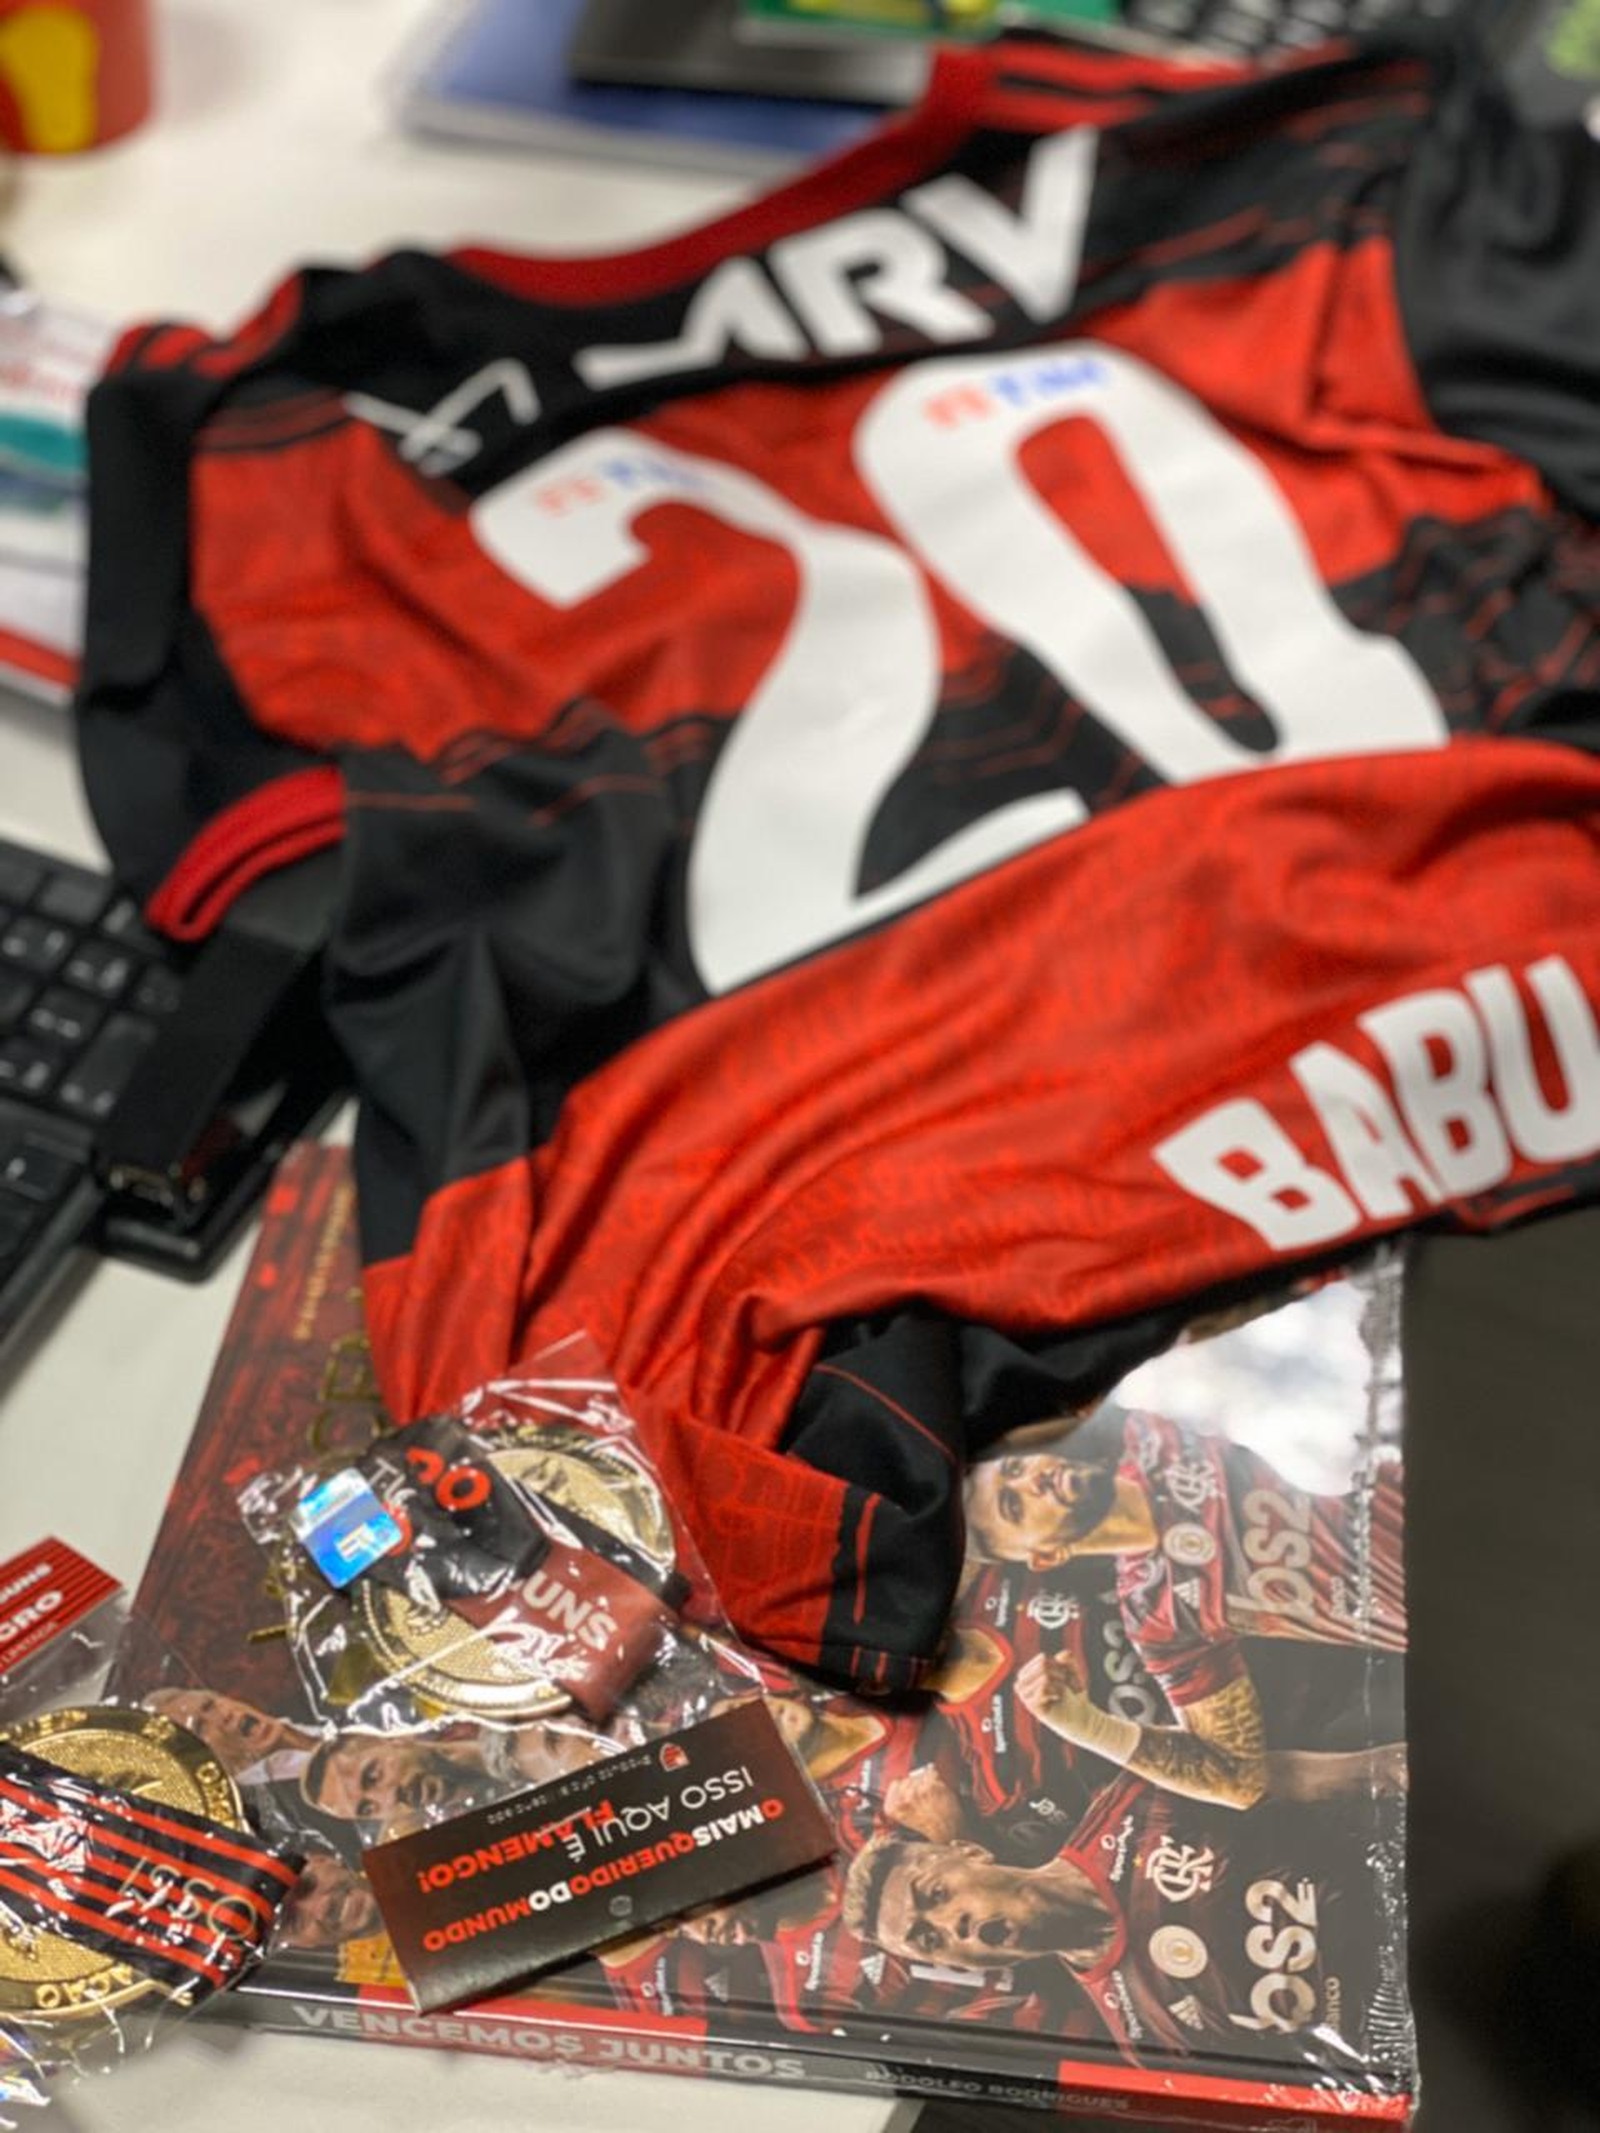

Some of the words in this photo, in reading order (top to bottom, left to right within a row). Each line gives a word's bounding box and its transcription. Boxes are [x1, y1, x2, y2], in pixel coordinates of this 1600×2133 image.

[468, 338, 1448, 998] 20
[1151, 954, 1600, 1250] BABU
[589, 1797, 672, 1847] AQUI
[681, 1766, 754, 1811] ISSO
[417, 1801, 616, 1893] FLAMENGO!
[1228, 1878, 1317, 2032] bs2
[295, 2006, 583, 2055] VENCEMOS
[599, 2039, 805, 2079] JUNTOS
